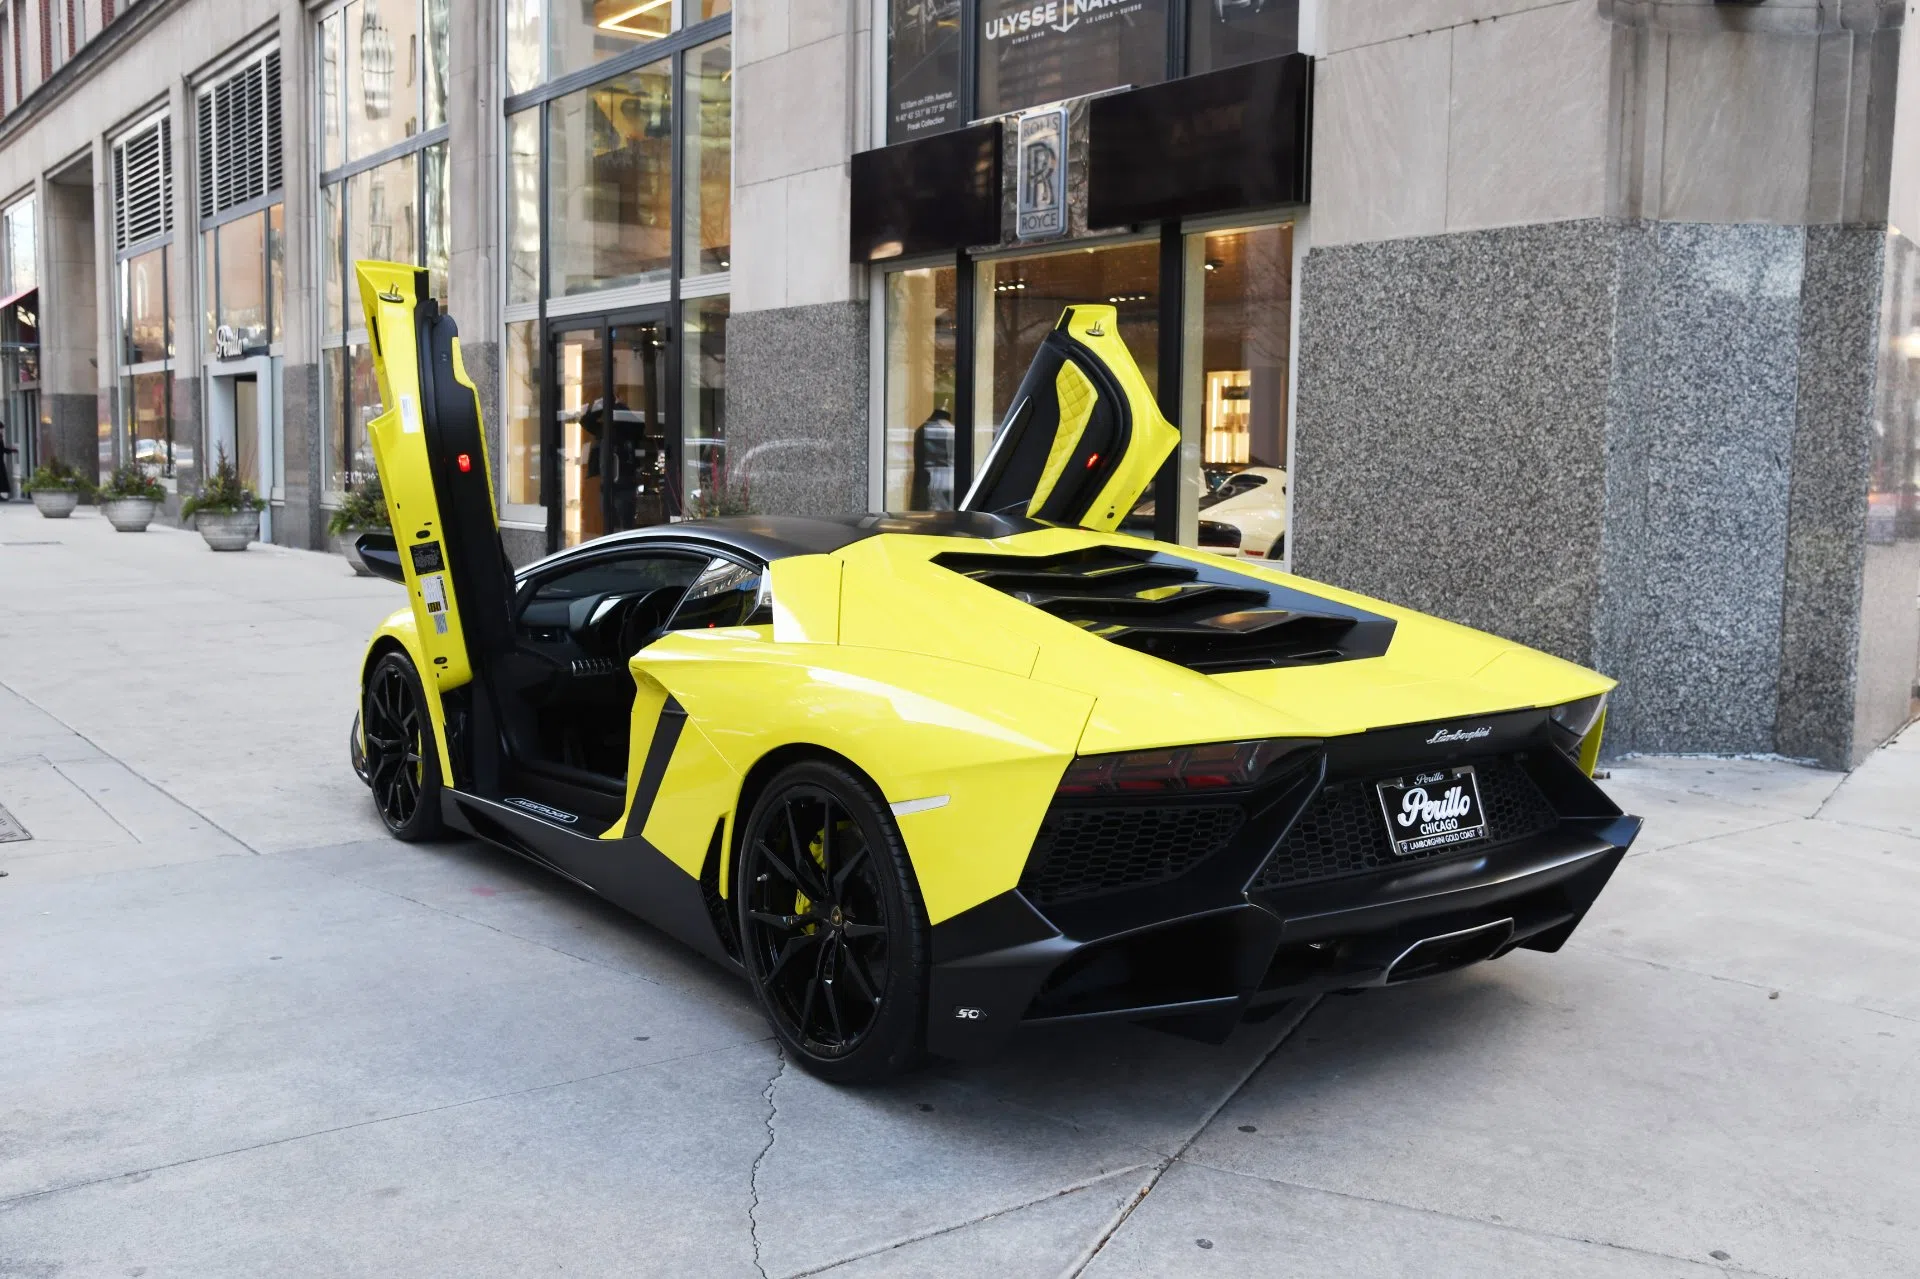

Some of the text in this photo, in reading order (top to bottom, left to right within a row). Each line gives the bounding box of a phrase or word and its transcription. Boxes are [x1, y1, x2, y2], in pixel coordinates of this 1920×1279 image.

[985, 1, 1058, 41] ULYSSE
[920, 116, 945, 128] Collection
[1021, 213, 1057, 231] ROYCE
[1426, 727, 1492, 744] Lamborghini
[1414, 772, 1445, 786] Perillo
[1397, 786, 1471, 827] Perillo
[1420, 818, 1458, 835] CHICAGO
[1409, 829, 1476, 850] LAMBORGHINI GOLD COAST
